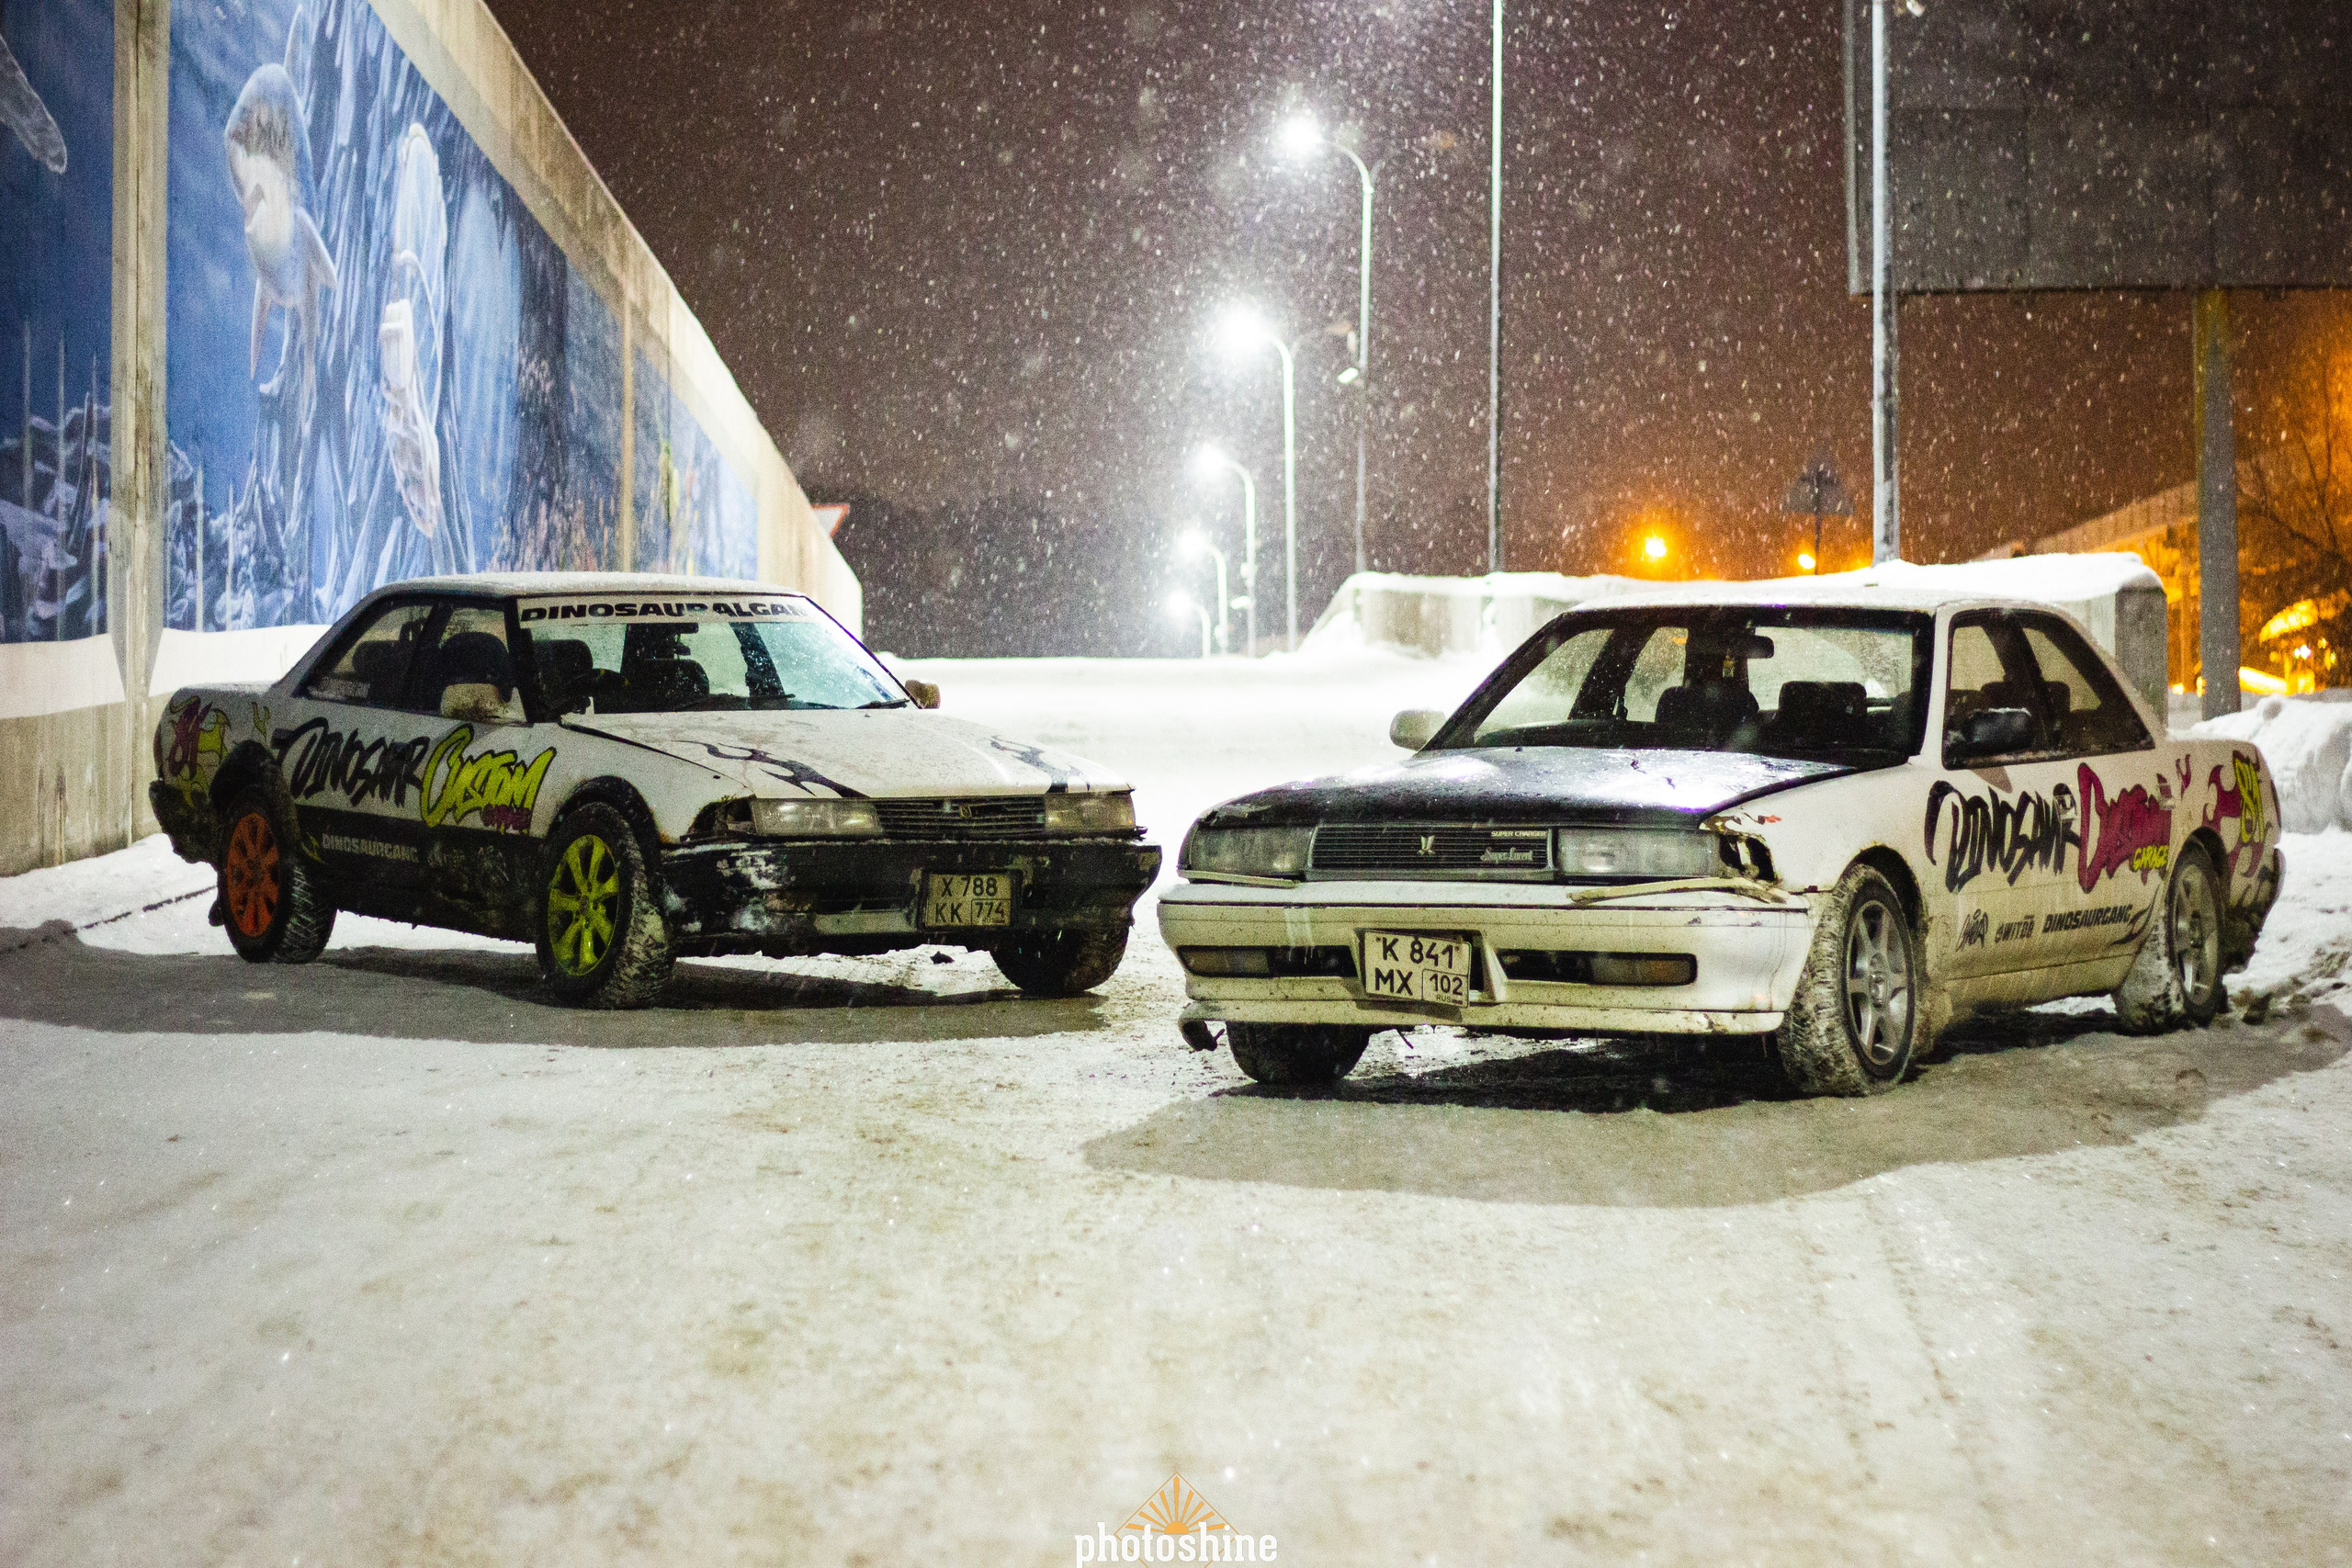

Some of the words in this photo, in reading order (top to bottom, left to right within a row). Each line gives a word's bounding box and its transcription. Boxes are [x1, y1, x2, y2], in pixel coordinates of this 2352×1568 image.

[1490, 829, 1514, 838] SUPER
[1514, 829, 1547, 838] CHARGER
[941, 876, 954, 897] X
[960, 874, 998, 897] 788
[934, 902, 963, 923] KK
[975, 901, 1005, 919] 774
[2041, 904, 2134, 934] DINOSAURGANG
[1382, 937, 1399, 962] K
[1410, 940, 1453, 969] 841
[1374, 967, 1414, 996] MX
[1430, 973, 1463, 996] 102
[1436, 994, 1452, 1003] RUS
